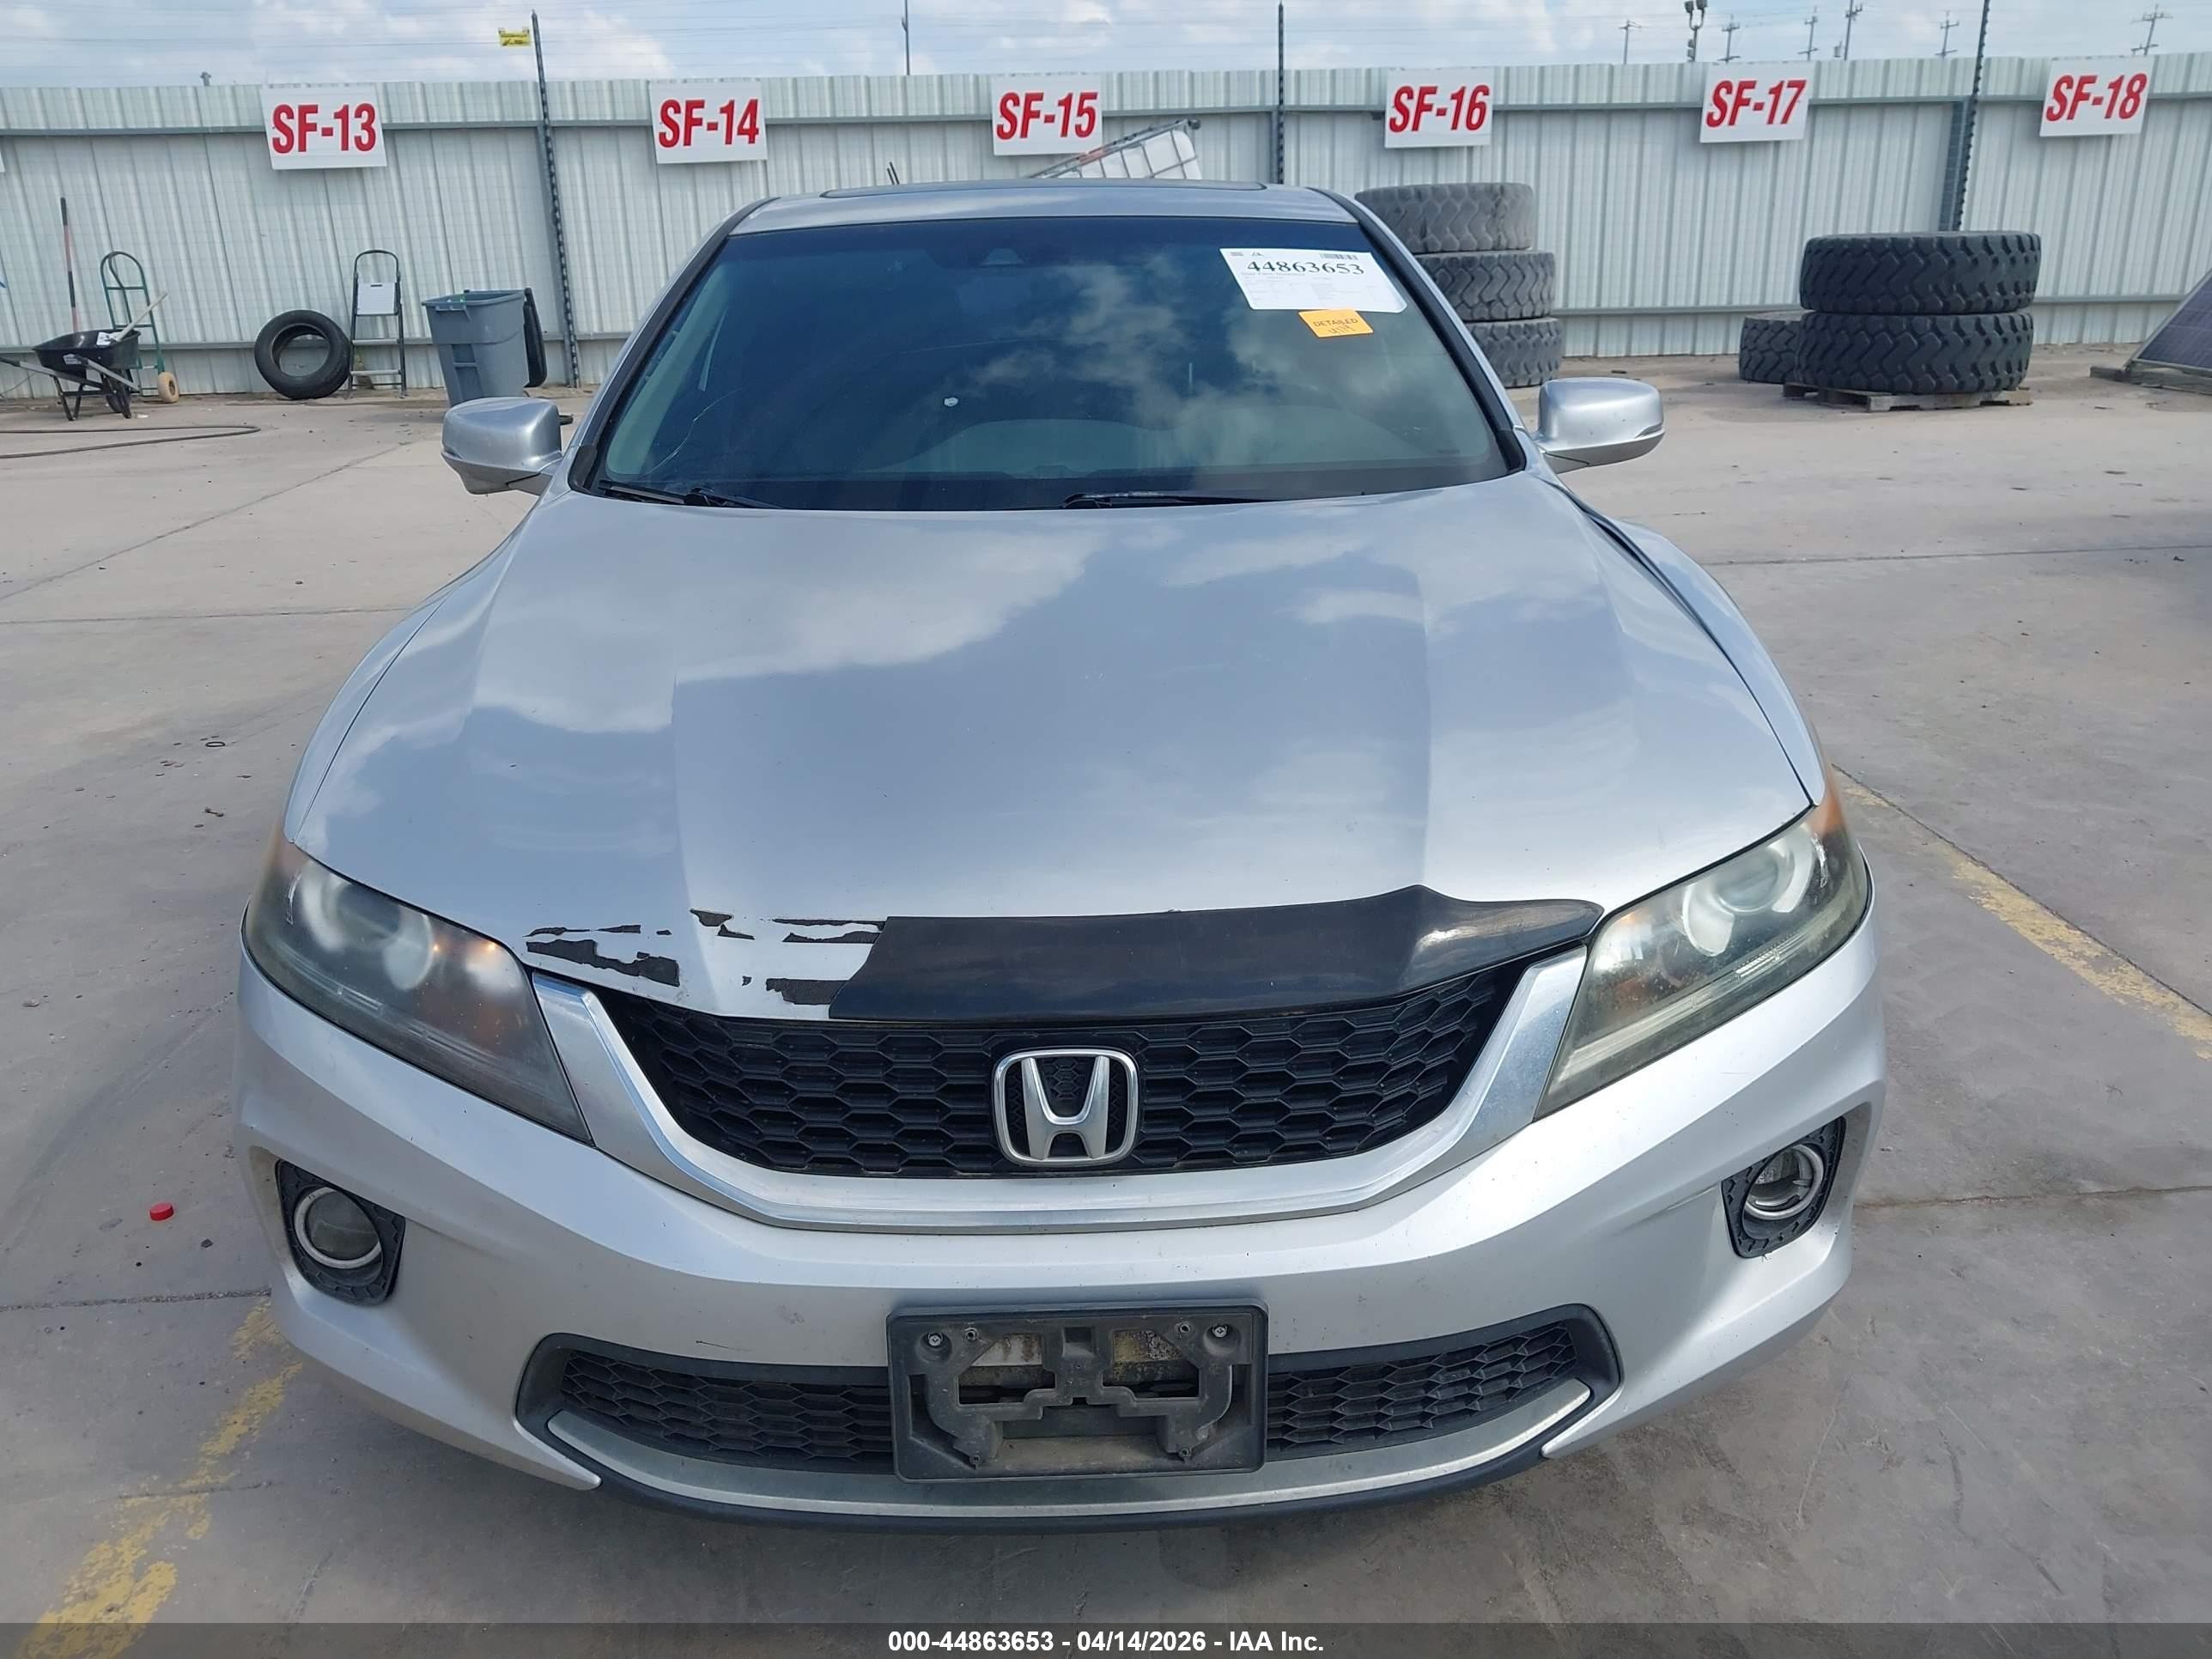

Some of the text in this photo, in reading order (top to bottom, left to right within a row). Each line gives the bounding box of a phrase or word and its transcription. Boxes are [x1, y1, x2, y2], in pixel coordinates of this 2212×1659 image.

[995, 91, 1097, 140] SF-15
[1389, 85, 1490, 132] SF-16
[1705, 80, 1806, 128] SF-17
[2046, 74, 2148, 122] SF-18
[272, 103, 376, 154] SF-13
[658, 99, 760, 148] SF-14
[1247, 260, 1364, 275] 44863653
[1313, 318, 1358, 327] DETAILED
